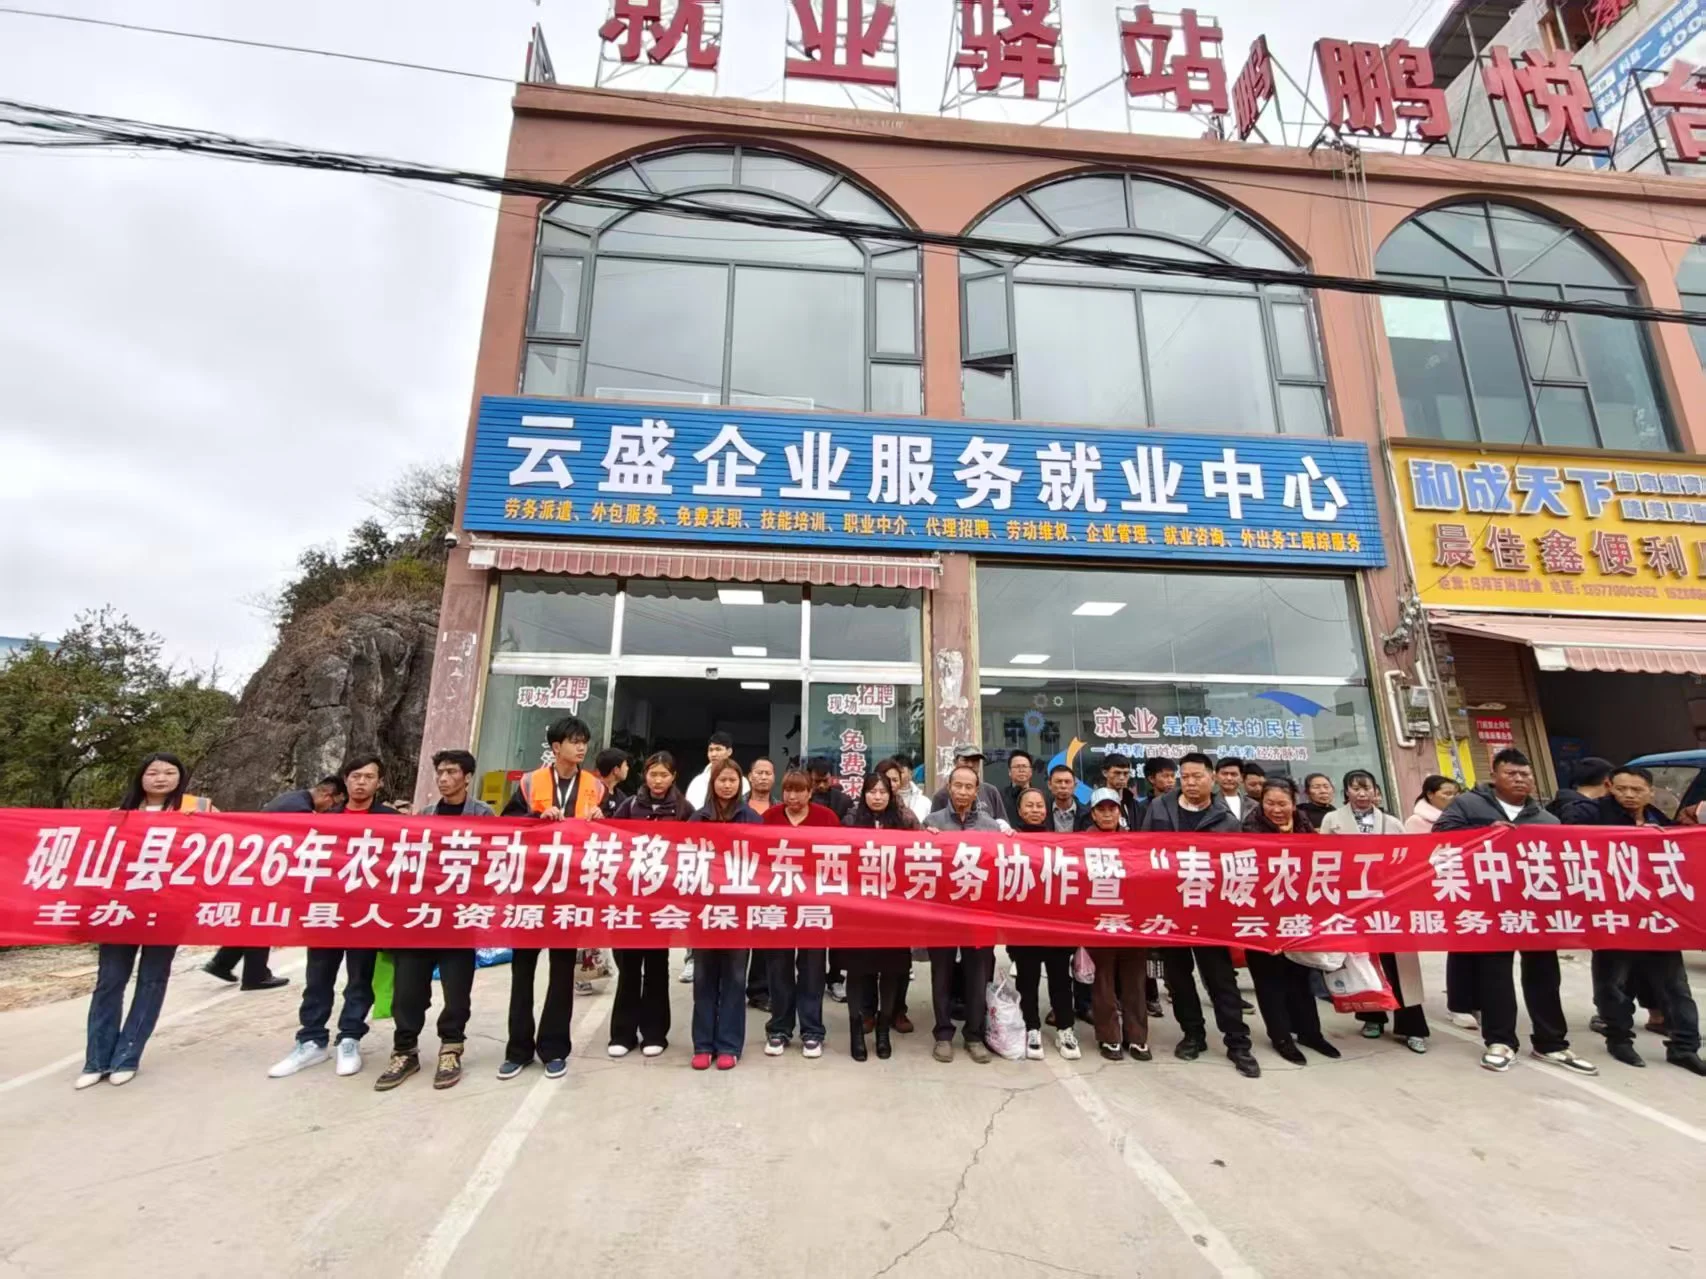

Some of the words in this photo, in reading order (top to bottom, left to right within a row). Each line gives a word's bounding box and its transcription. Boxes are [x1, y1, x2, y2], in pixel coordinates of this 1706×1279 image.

[506, 414, 1349, 522] 云盛企业服务就业中心
[1408, 457, 1614, 518] 和成天下
[1434, 522, 1706, 579] 晨佳鑫便利
[518, 677, 590, 716] 现场招聘
[828, 684, 895, 722] 现场招聘
[1093, 706, 1305, 739] 就业是最基本的民生
[839, 728, 867, 806] 免费求
[33, 899, 835, 931] 主办：砚山县人力资源和社会保障局
